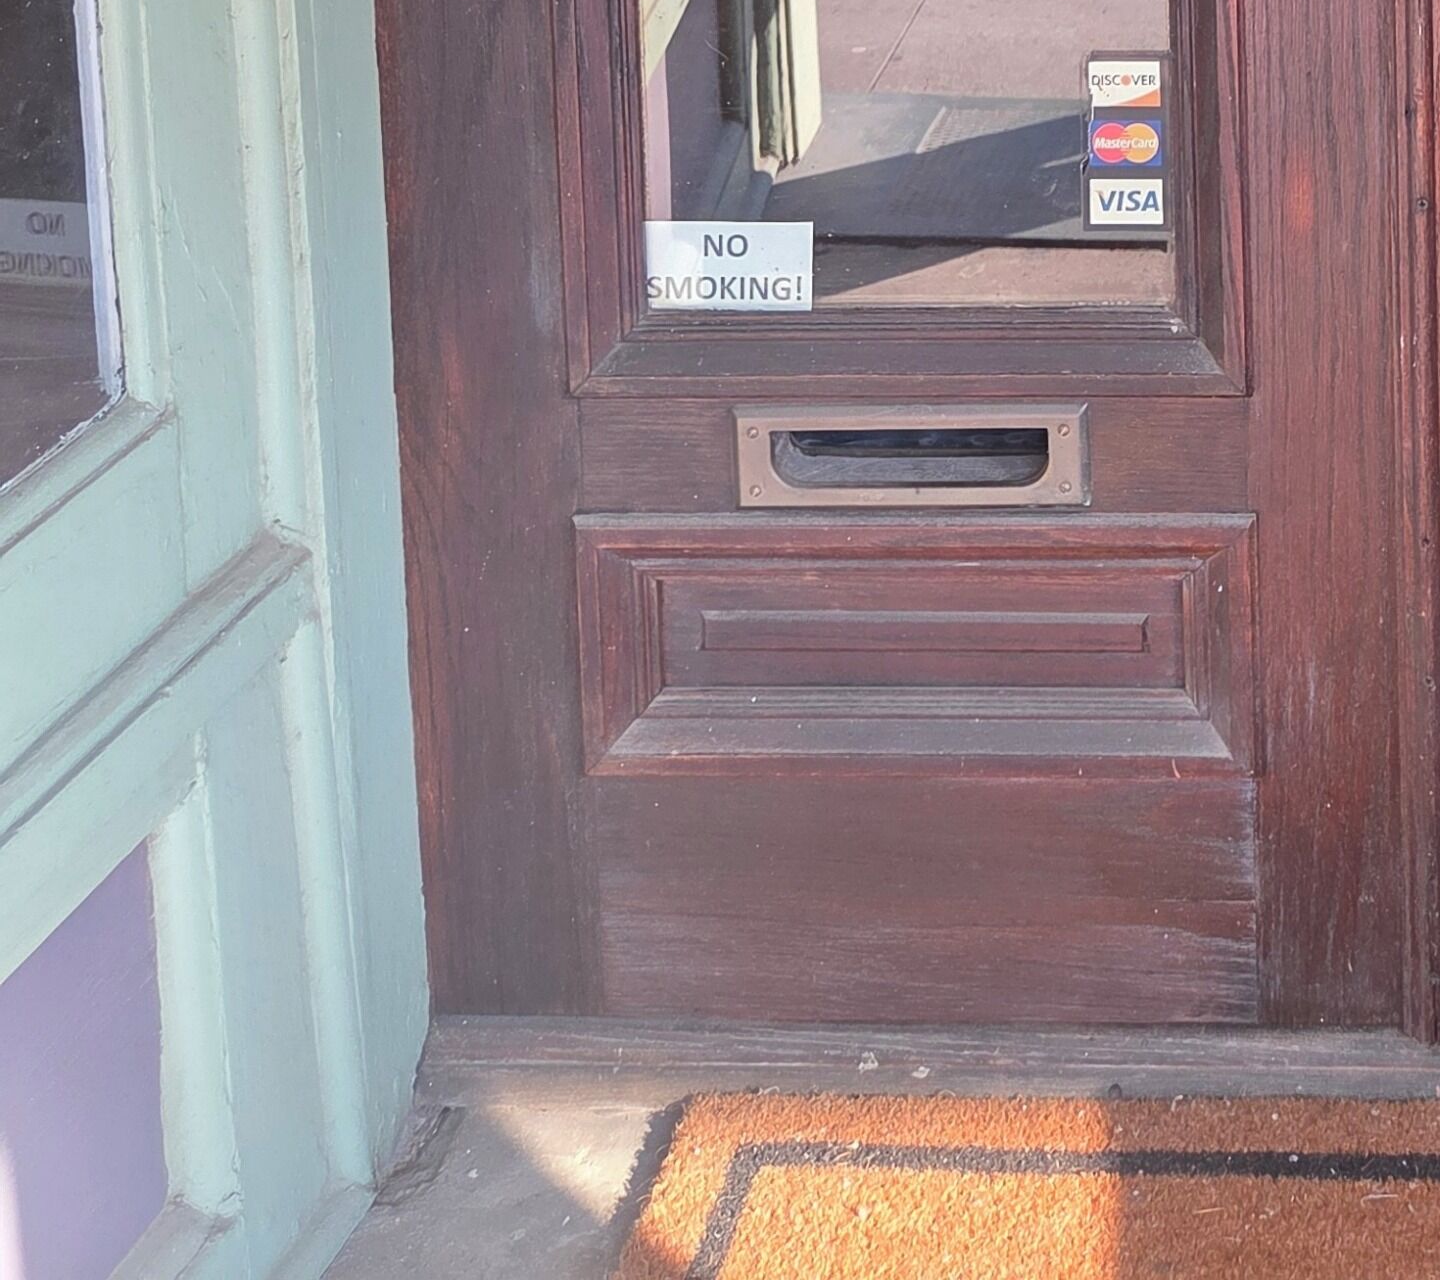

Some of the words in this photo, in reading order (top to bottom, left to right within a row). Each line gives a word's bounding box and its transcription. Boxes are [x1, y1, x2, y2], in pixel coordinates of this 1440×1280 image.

[1091, 72, 1157, 87] DISCOVER
[1094, 134, 1158, 150] MasterCard
[1097, 189, 1160, 213] VISA
[702, 233, 748, 258] NO
[646, 276, 803, 301] SMOKING!
